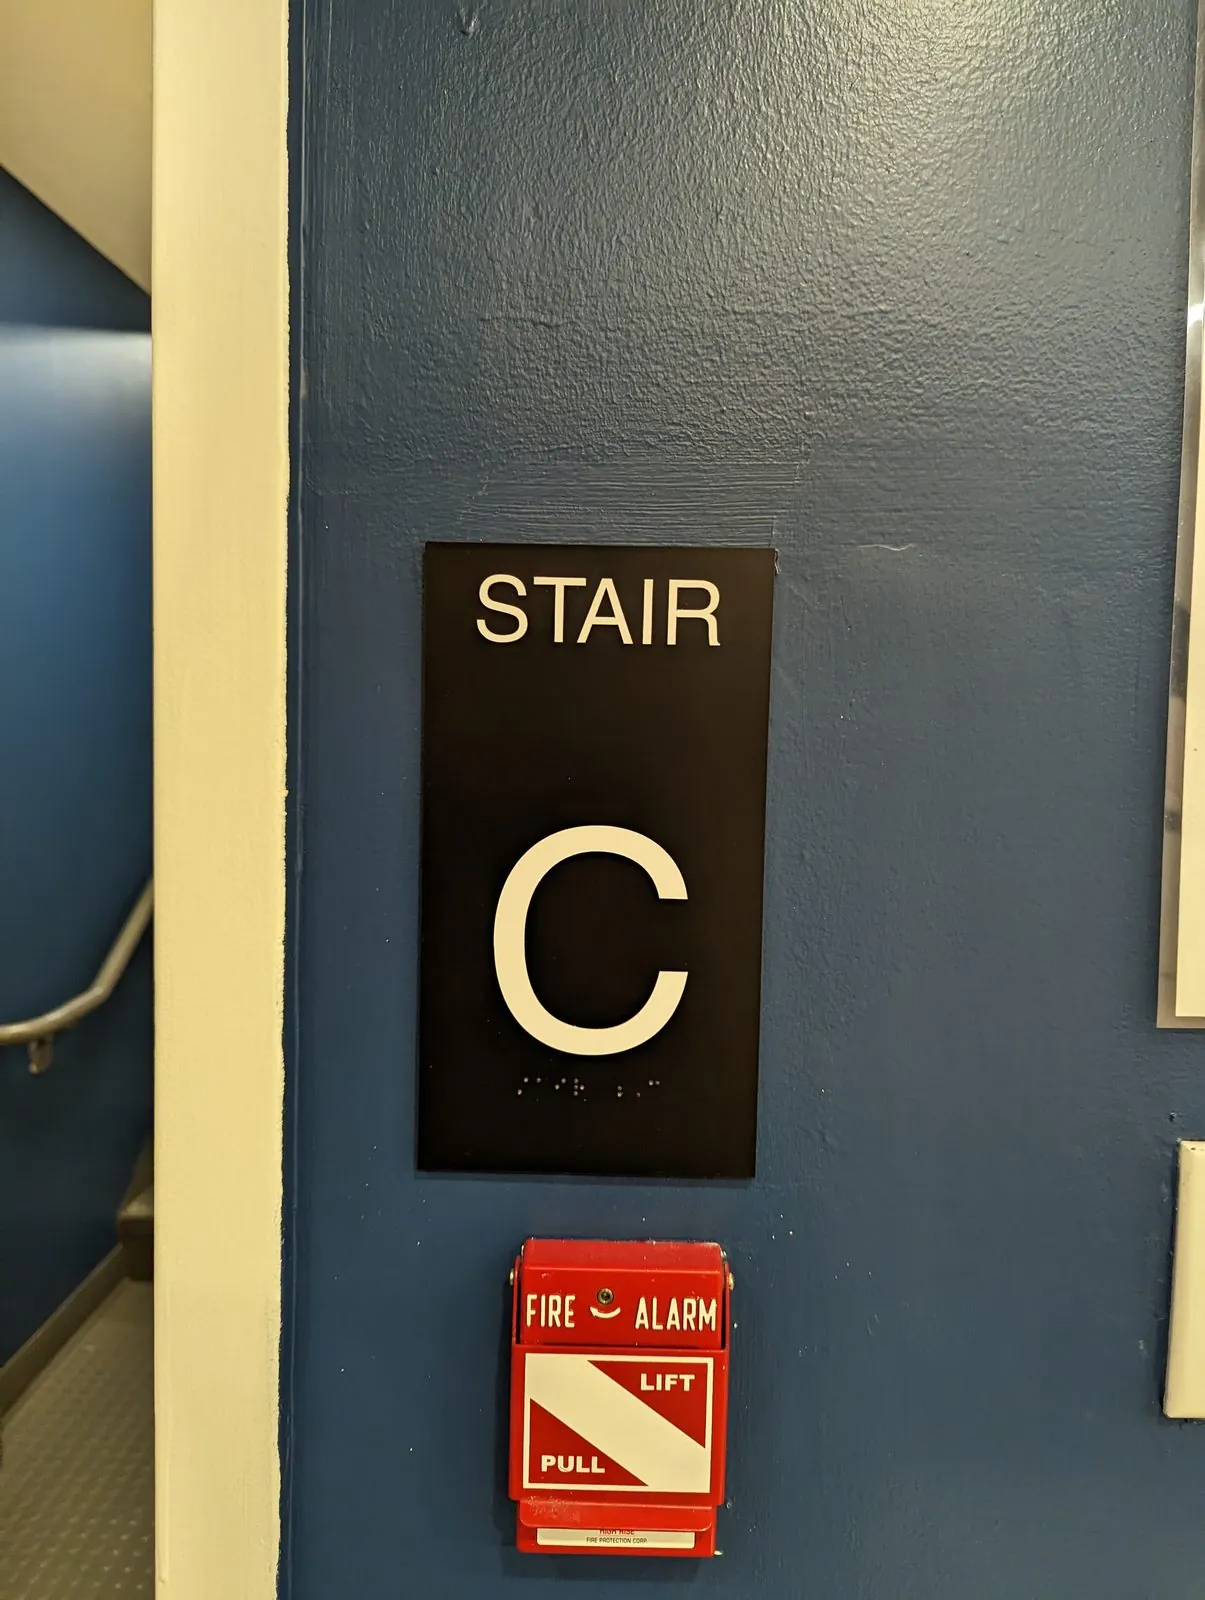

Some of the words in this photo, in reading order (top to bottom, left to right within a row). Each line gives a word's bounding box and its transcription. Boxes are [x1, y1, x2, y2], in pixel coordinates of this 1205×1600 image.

[477, 574, 721, 647] STAIR
[493, 825, 689, 1056] C
[526, 1294, 576, 1328] FIRE
[635, 1297, 717, 1331] ALARM
[640, 1373, 695, 1391] LIFT
[541, 1455, 606, 1473] PULL
